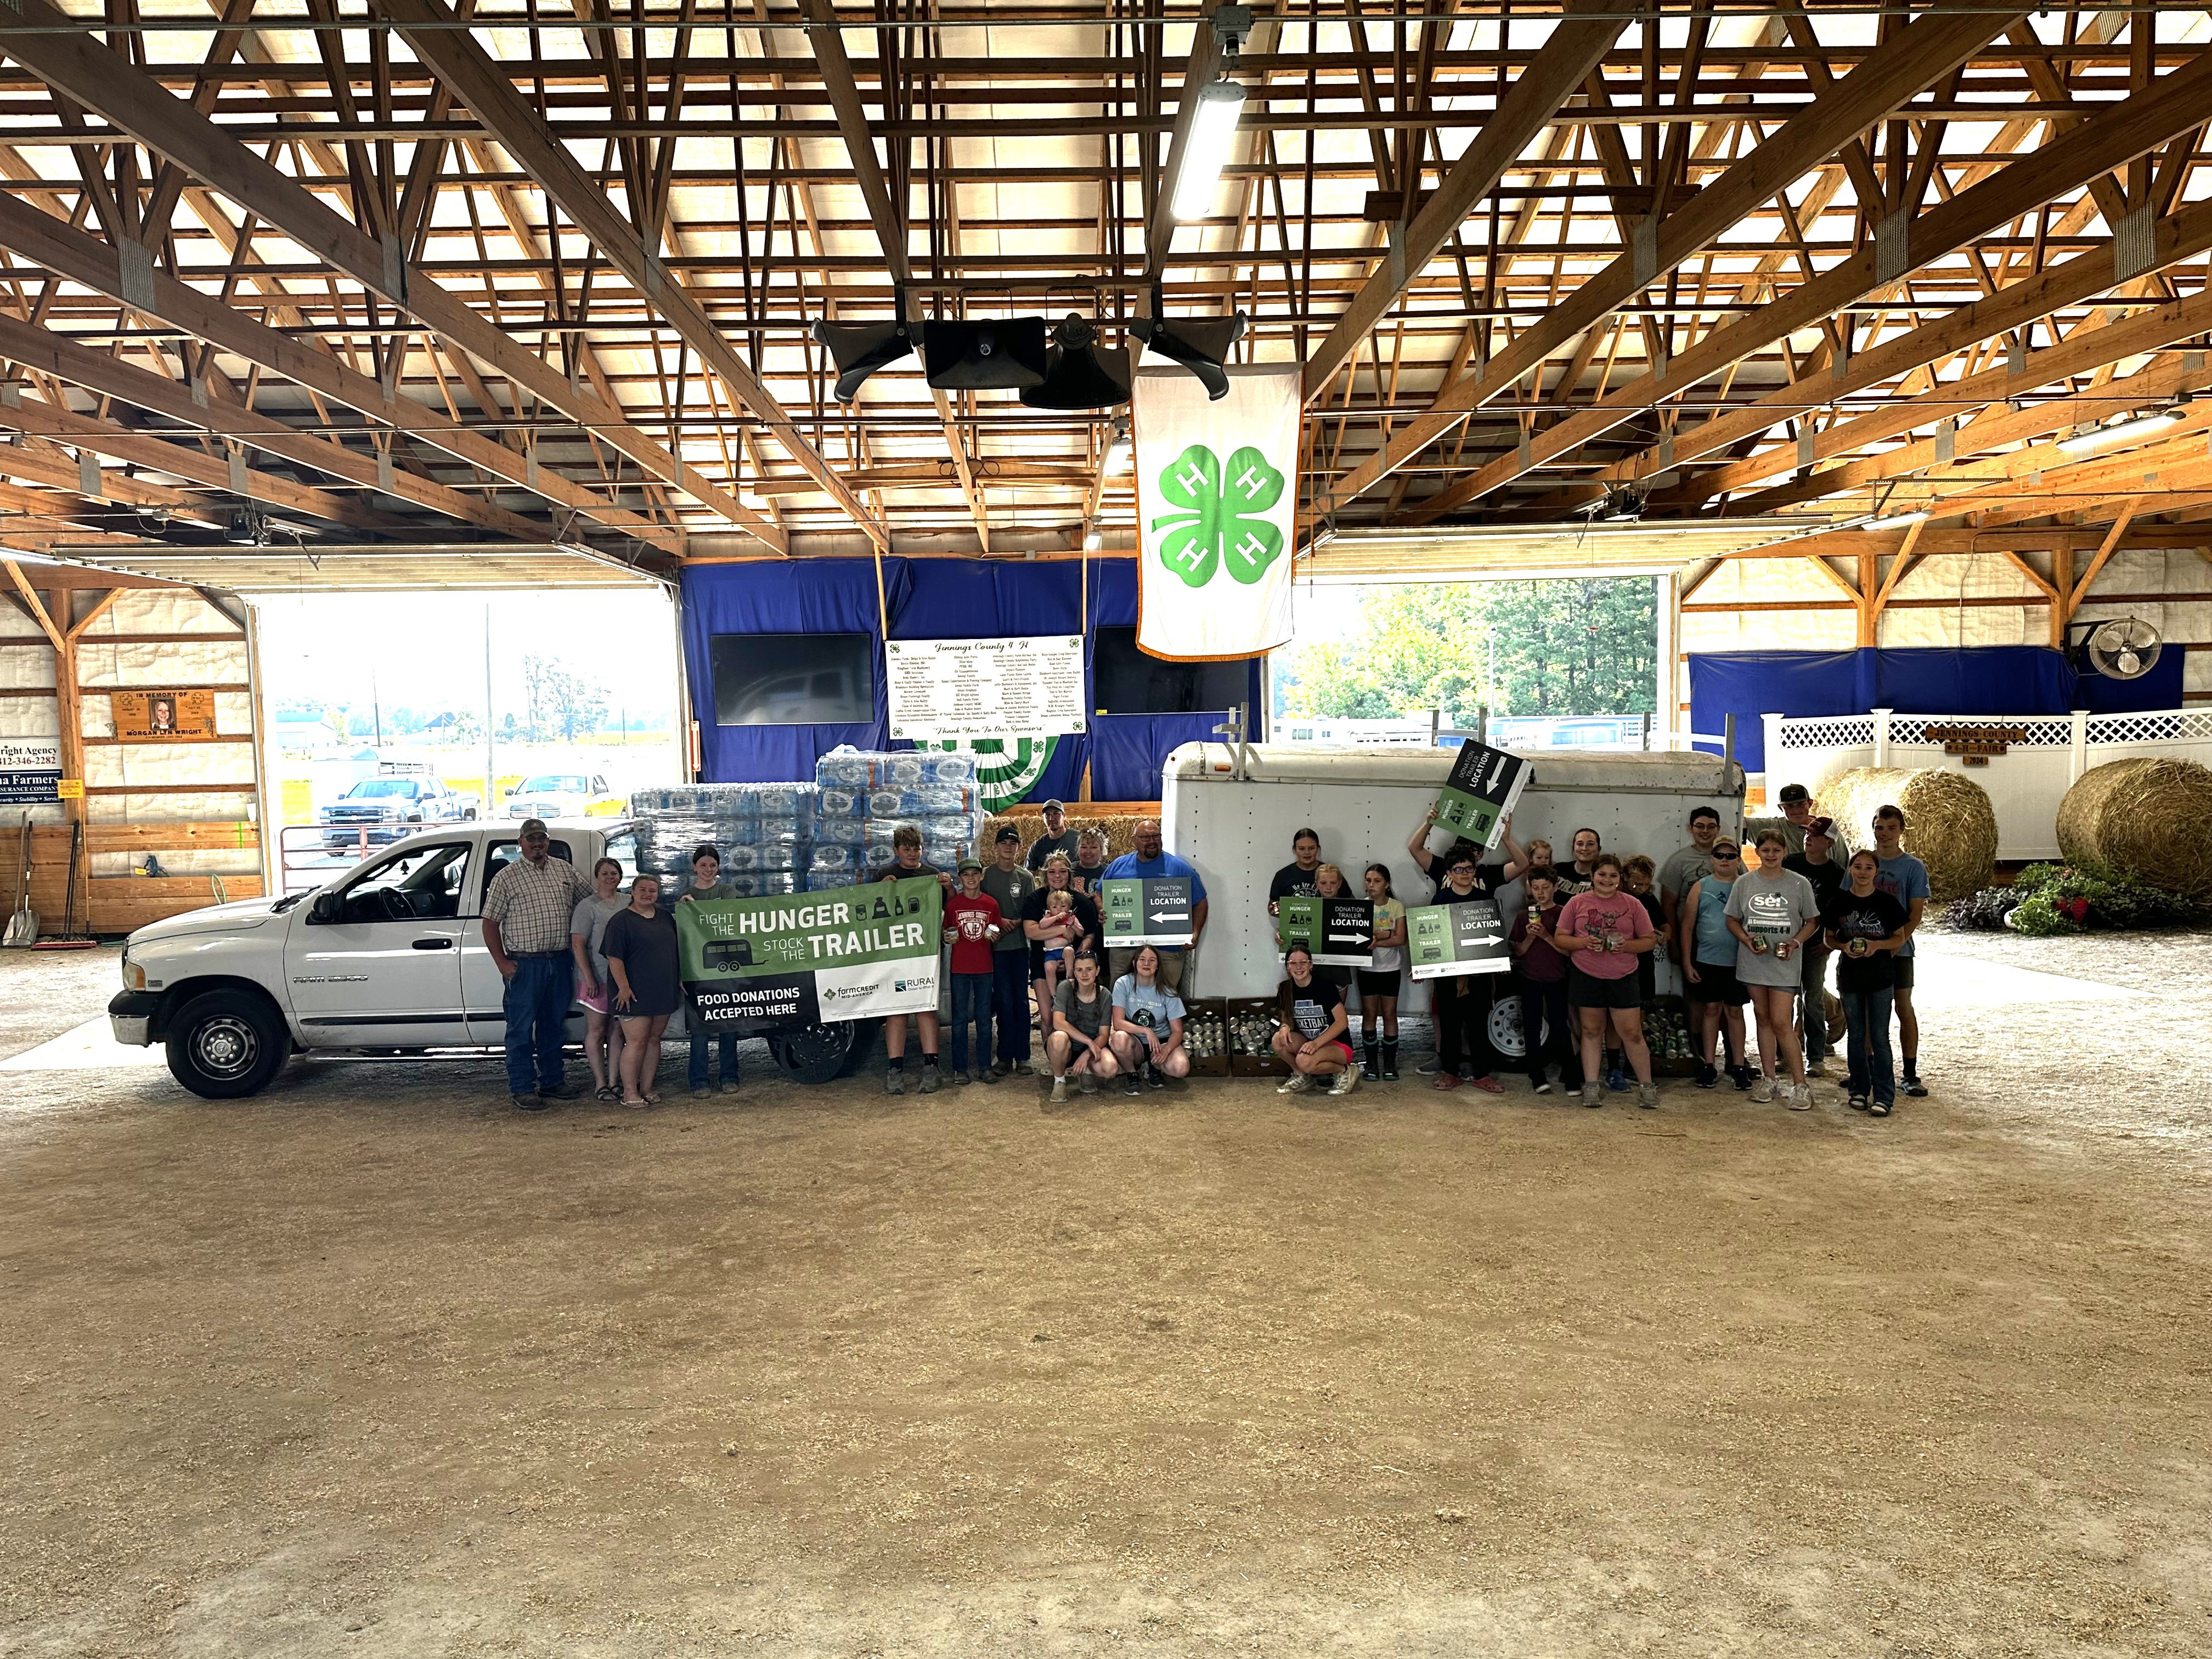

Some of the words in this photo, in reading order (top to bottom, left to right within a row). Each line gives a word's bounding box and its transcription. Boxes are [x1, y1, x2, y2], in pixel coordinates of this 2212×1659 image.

[1176, 461, 1209, 497] H
[1235, 465, 1267, 500] H
[1176, 537, 1209, 572] H
[1235, 531, 1267, 566] H
[935, 643, 972, 654] Jennings
[975, 642, 1005, 653] County
[1934, 730, 1979, 738] JENNINGS
[1983, 730, 2018, 738] COUNTY
[25, 747, 57, 756] Agency
[1458, 750, 1475, 778] DONATION
[1466, 755, 1480, 777] TRAILER
[1469, 751, 1491, 788] LOCATION
[13, 775, 58, 785] Farmers
[1442, 799, 1454, 820] HUNGER
[1466, 809, 1479, 830] TRAILER
[699, 913, 734, 925] FIGHT
[740, 902, 850, 934] HUNGER
[1461, 919, 1500, 930] LOCATION
[712, 925, 735, 936] THE
[1747, 925, 1778, 934] Supports
[764, 936, 804, 951] STOCK
[808, 923, 925, 958] TRAILER
[781, 949, 805, 961] THE
[907, 977, 935, 987] RURAL
[697, 994, 730, 1006] FOOD
[731, 987, 800, 1003] DONATIONS
[704, 1006, 764, 1021] ACCEPTED
[766, 1003, 797, 1015] HERE
